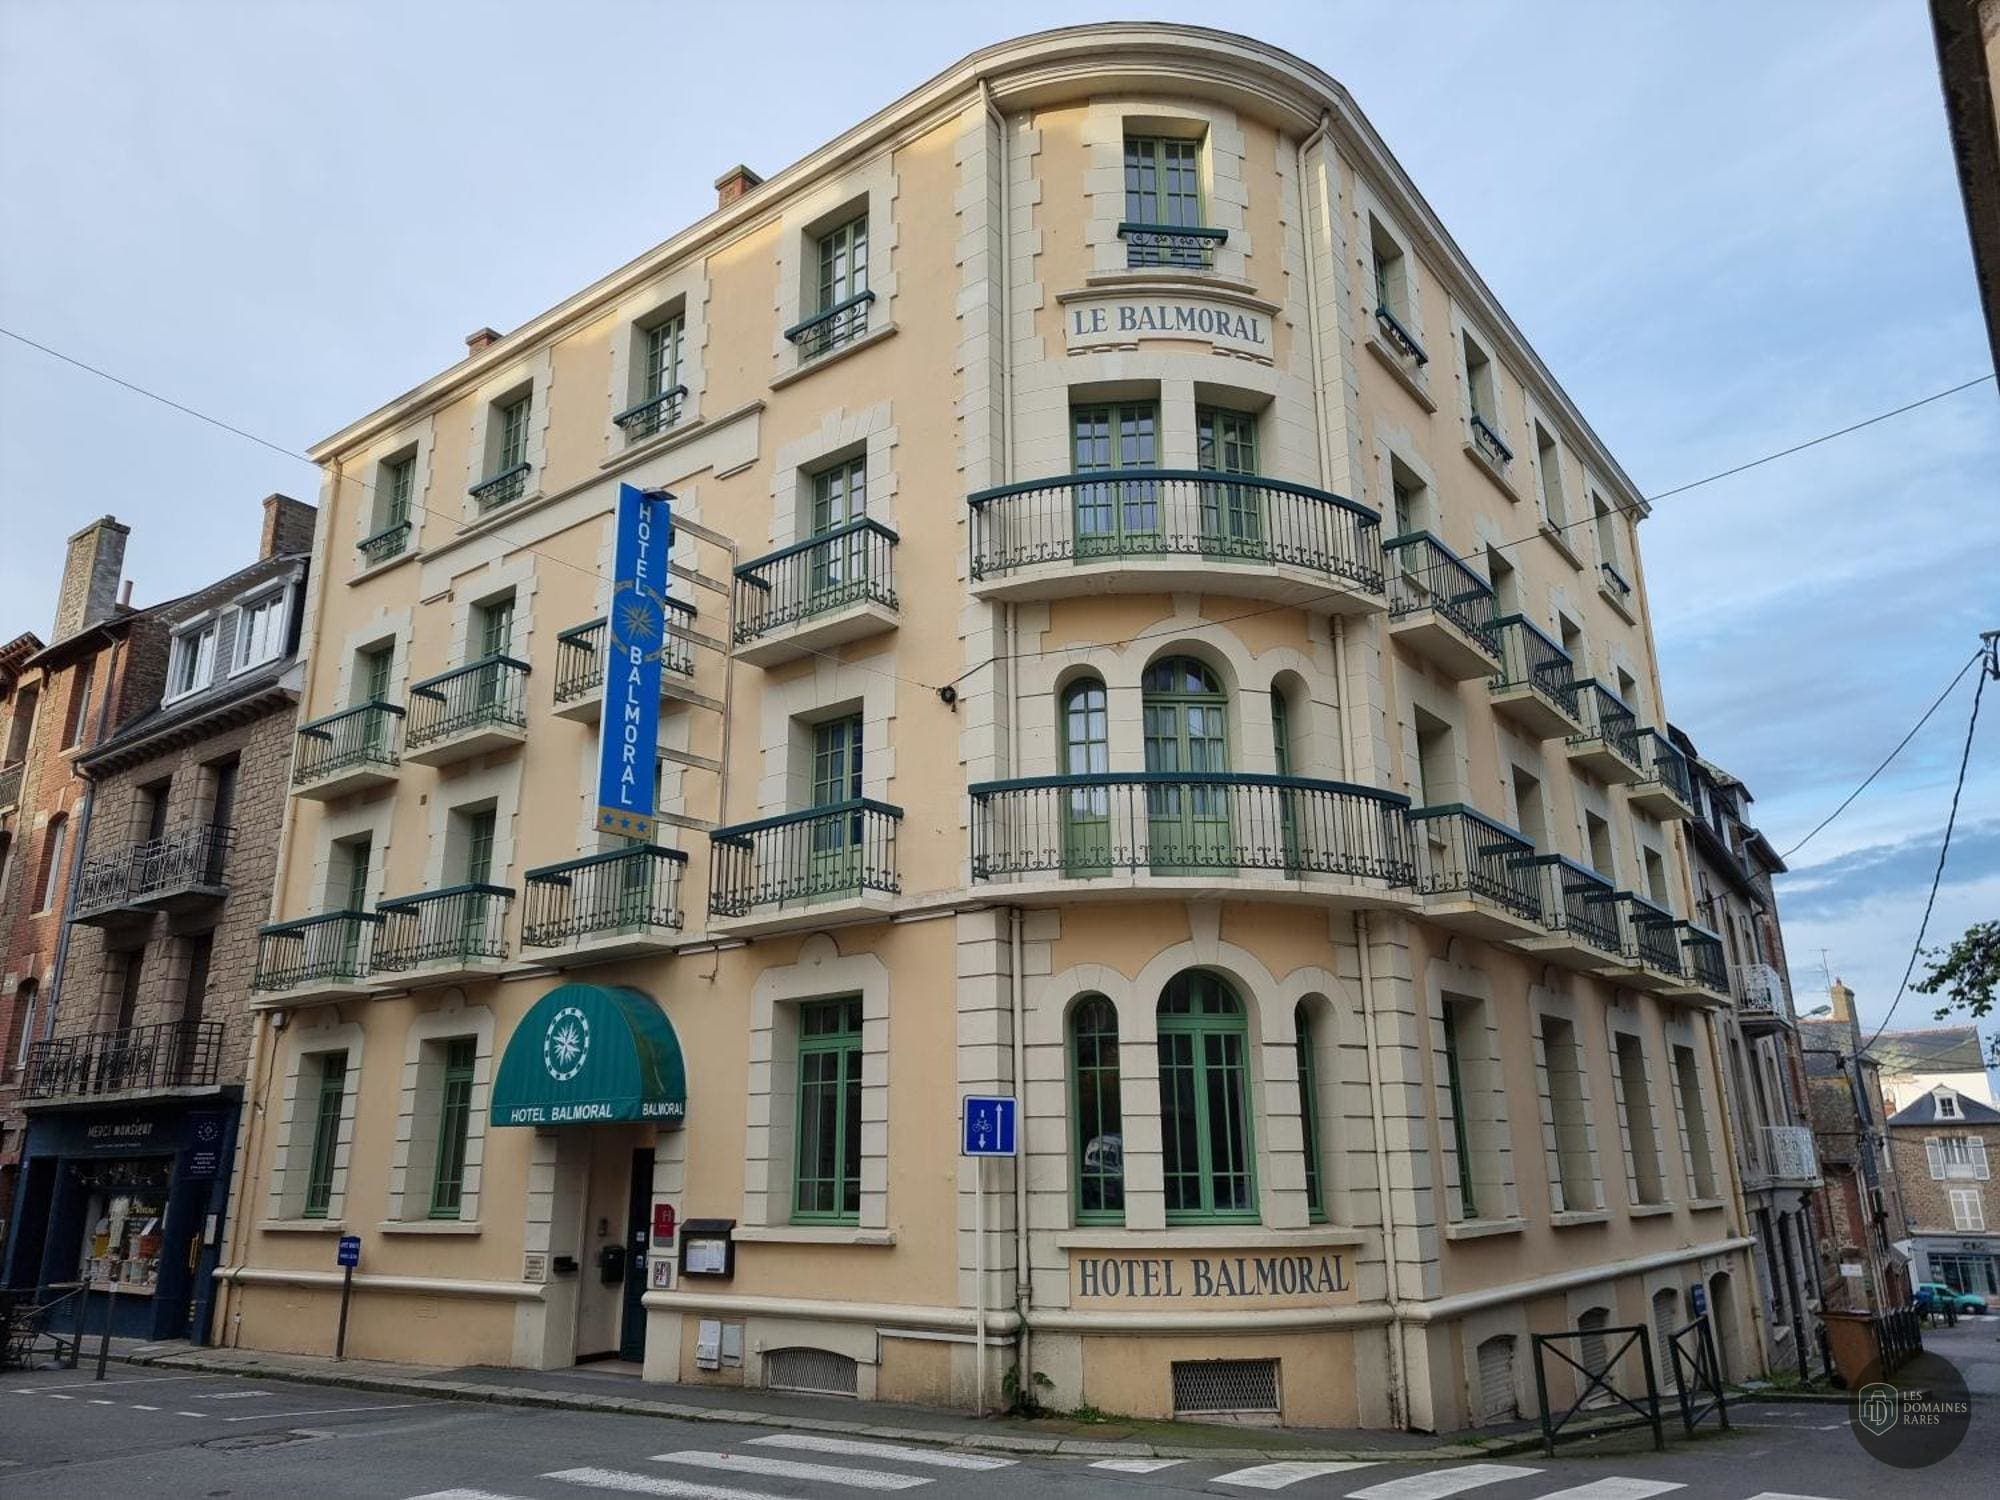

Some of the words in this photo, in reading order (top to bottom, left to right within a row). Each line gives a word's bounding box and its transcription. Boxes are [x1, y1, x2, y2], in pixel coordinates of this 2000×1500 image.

[1074, 307, 1108, 335] LE
[1118, 306, 1265, 344] BALMORAL
[635, 502, 651, 597] HOTEL
[621, 645, 643, 805] BALMORAL
[511, 1107, 546, 1122] HOTEL
[551, 1103, 614, 1121] BALMORAL
[642, 1102, 684, 1116] BALMORAL
[1078, 1258, 1182, 1297] HOTEL
[1191, 1255, 1350, 1297] BALMORAL
